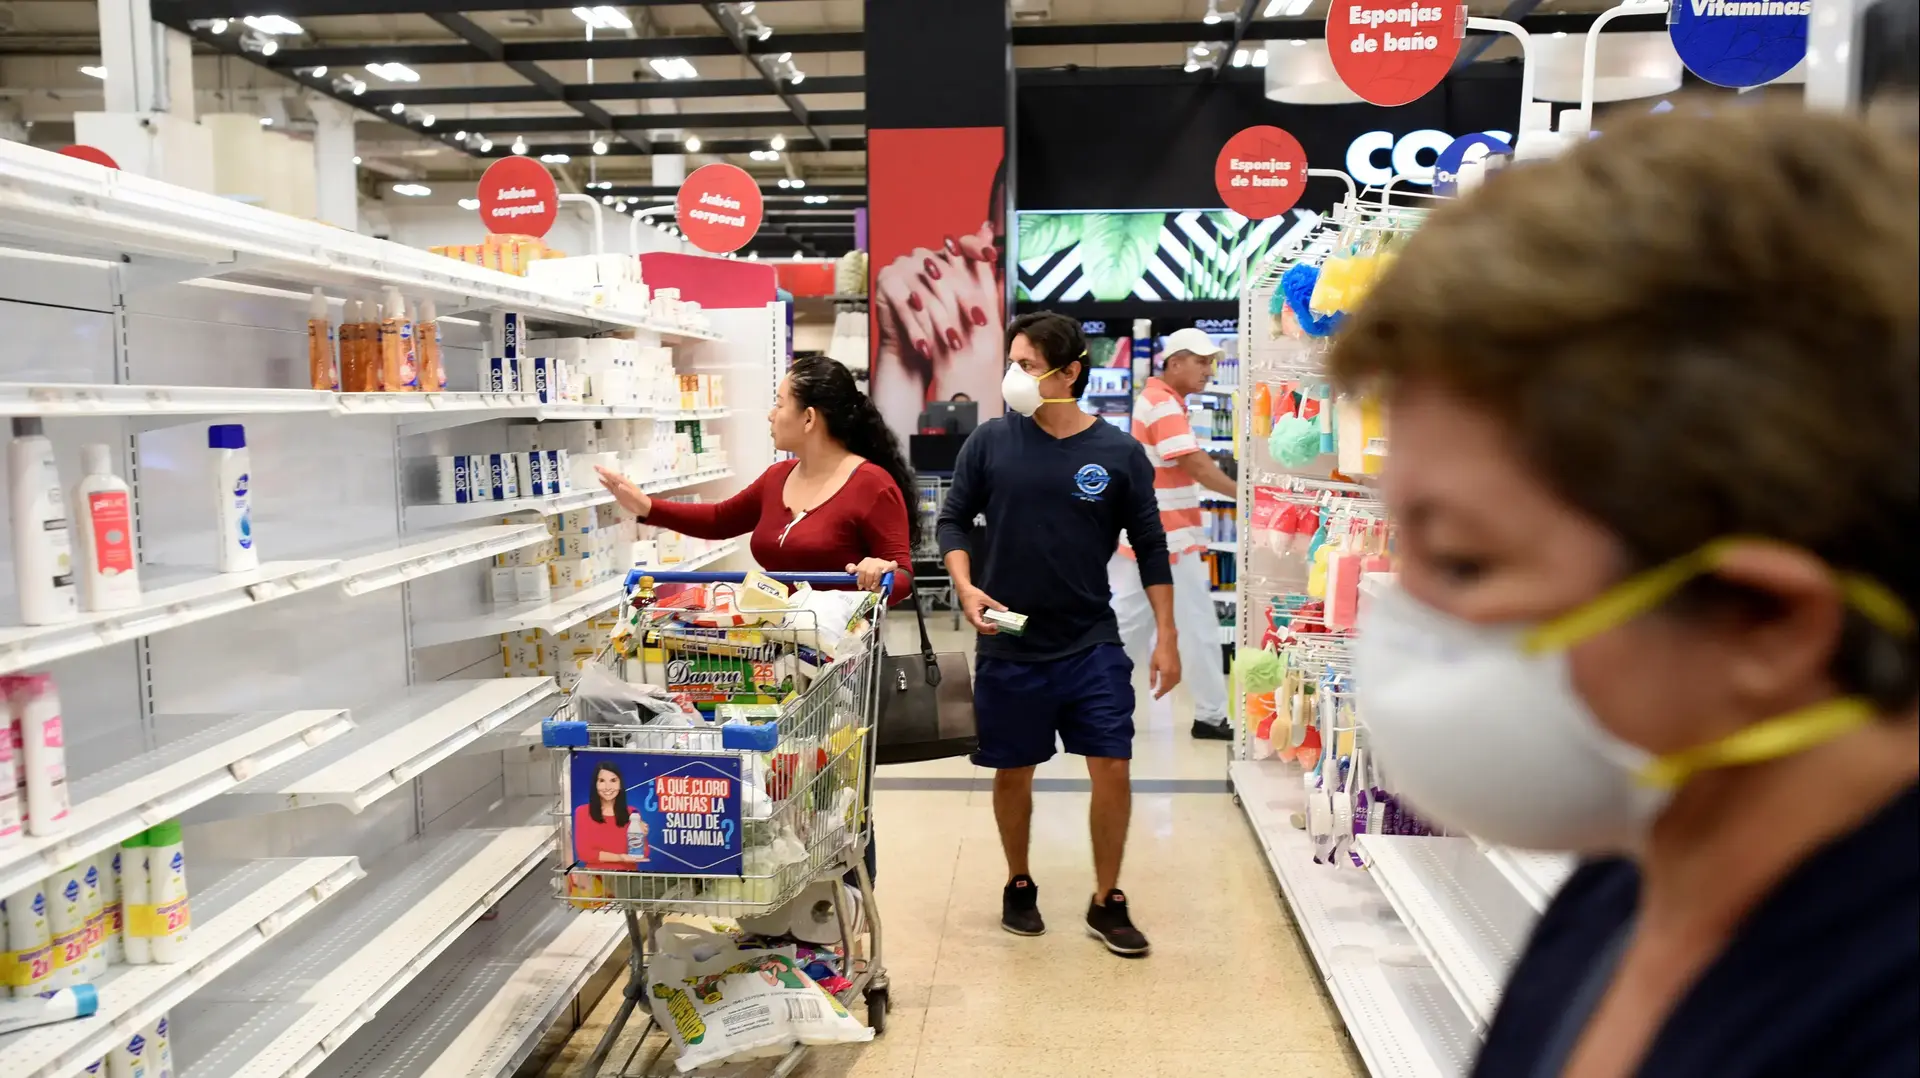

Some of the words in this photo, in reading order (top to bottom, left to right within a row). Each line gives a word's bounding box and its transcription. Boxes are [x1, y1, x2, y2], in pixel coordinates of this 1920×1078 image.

[1349, 1, 1442, 28] Esponjas
[1689, 0, 1812, 17] Vitaminas
[1350, 33, 1378, 53] de
[1383, 31, 1438, 52] baño
[1230, 158, 1292, 173] Esponjas
[1231, 174, 1250, 187] de
[1252, 174, 1289, 187] baño
[497, 186, 537, 200] Jabón
[699, 192, 741, 210] Jabón
[492, 201, 545, 218] corporal
[689, 209, 746, 228] corporal
[754, 664, 774, 678] 25
[656, 778, 665, 794] A
[667, 775, 691, 797] QUÉ
[691, 780, 728, 797] CLORO
[661, 793, 708, 813] CONFÍAS
[711, 797, 725, 813] LA
[666, 812, 702, 829] SALUD
[705, 814, 720, 830] DE
[662, 829, 677, 845] TU
